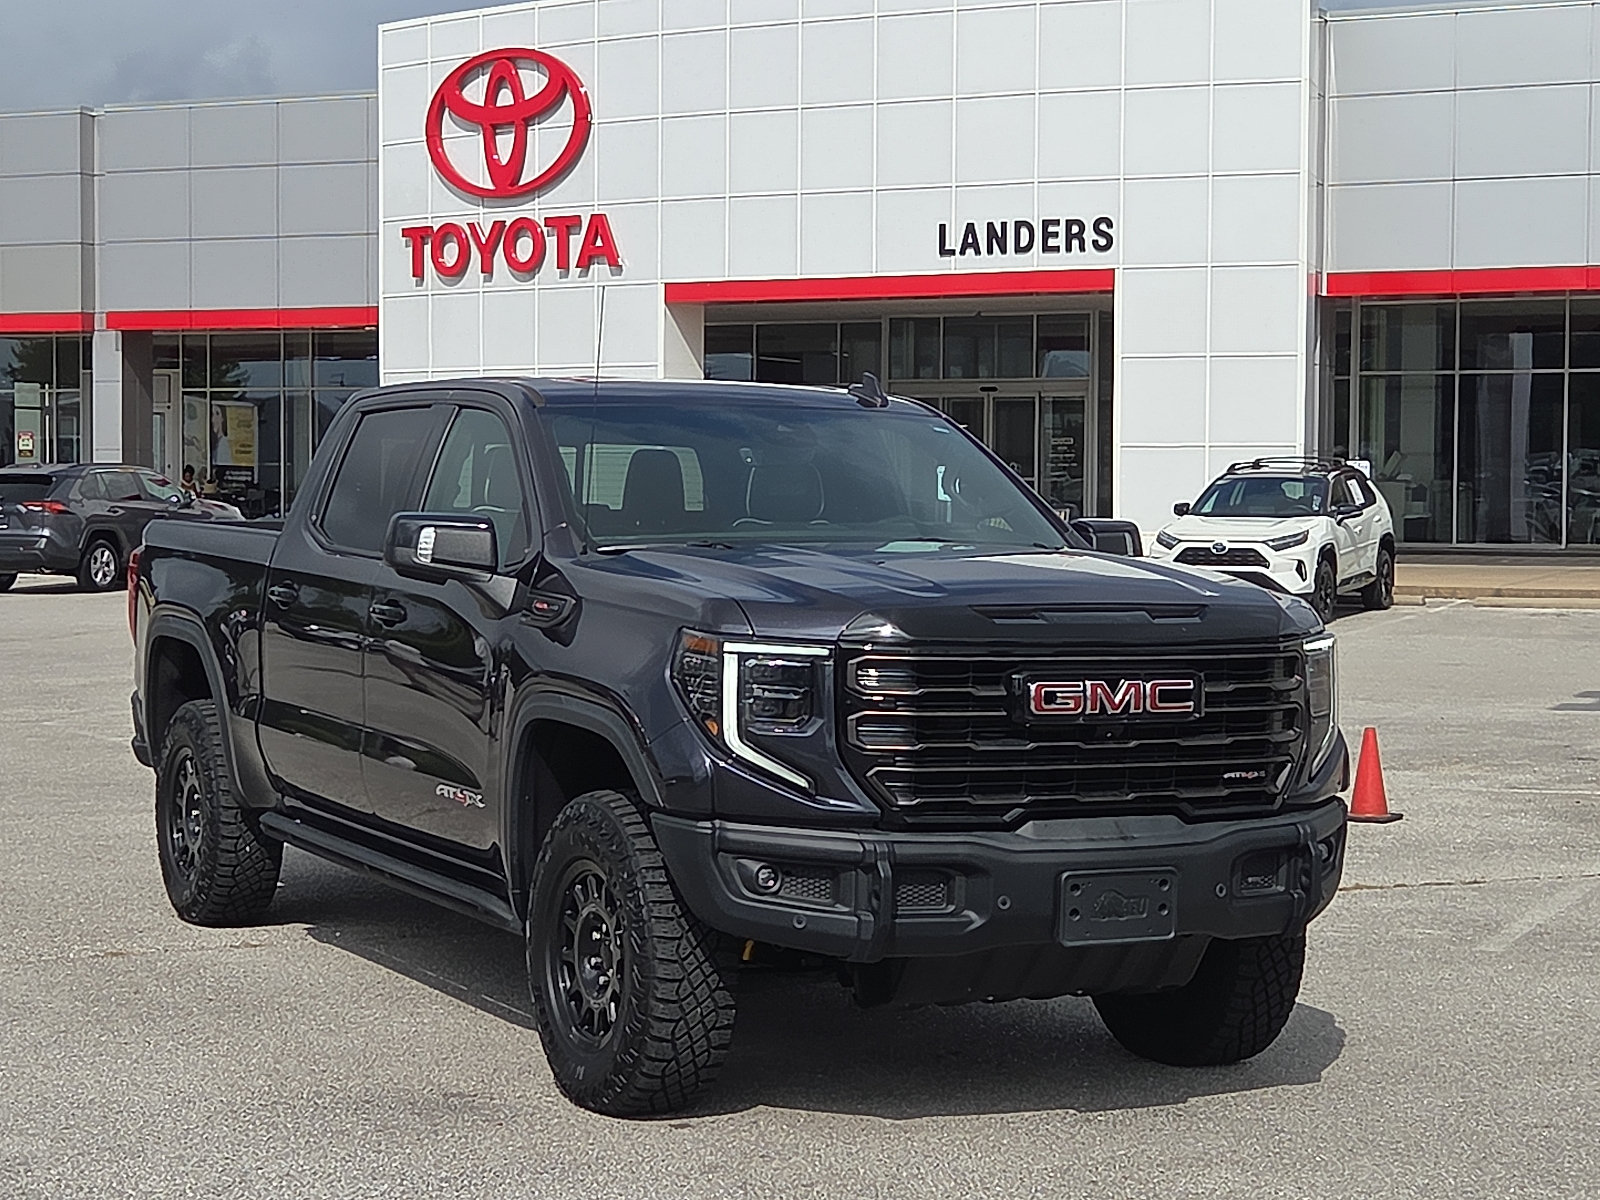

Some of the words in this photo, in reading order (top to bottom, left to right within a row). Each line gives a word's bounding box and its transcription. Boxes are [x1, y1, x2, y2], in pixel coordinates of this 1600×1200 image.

[401, 213, 621, 282] TOYOTA
[938, 216, 1114, 257] LANDERS
[1028, 679, 1194, 715] GMC
